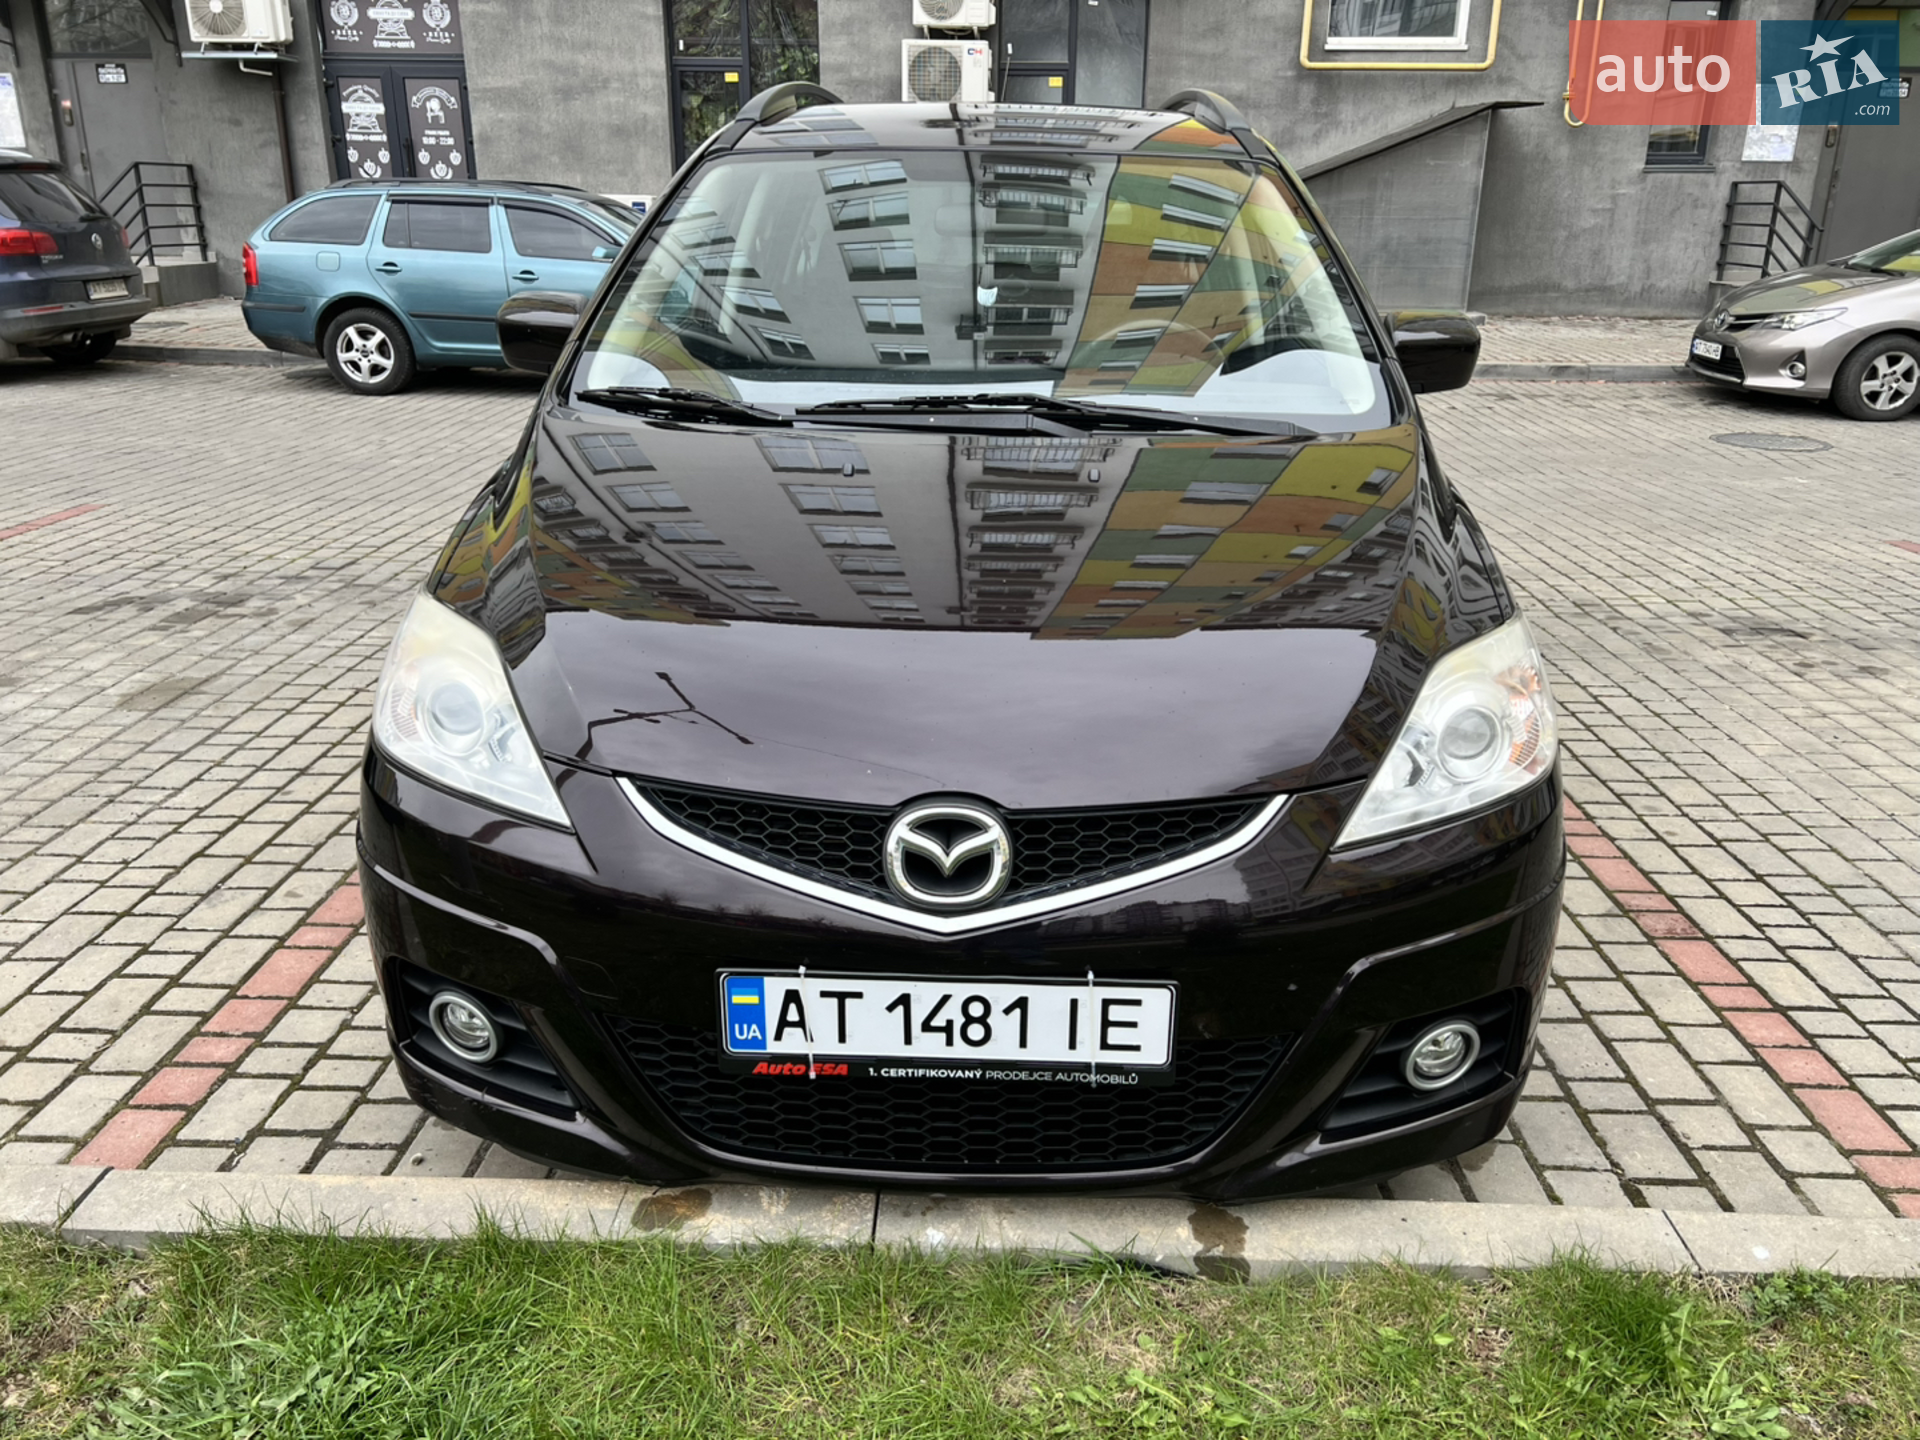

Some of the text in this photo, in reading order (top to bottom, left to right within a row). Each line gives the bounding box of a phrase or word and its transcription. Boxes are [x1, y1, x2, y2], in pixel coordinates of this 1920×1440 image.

[773, 988, 1143, 1052] AT 1481 IE
[734, 1023, 763, 1041] UA
[752, 1061, 849, 1076] Auto ESA
[868, 1066, 1139, 1085] 1. CERTIFIKOVANÝ PRODEJCE AUTOMOBILŮ
